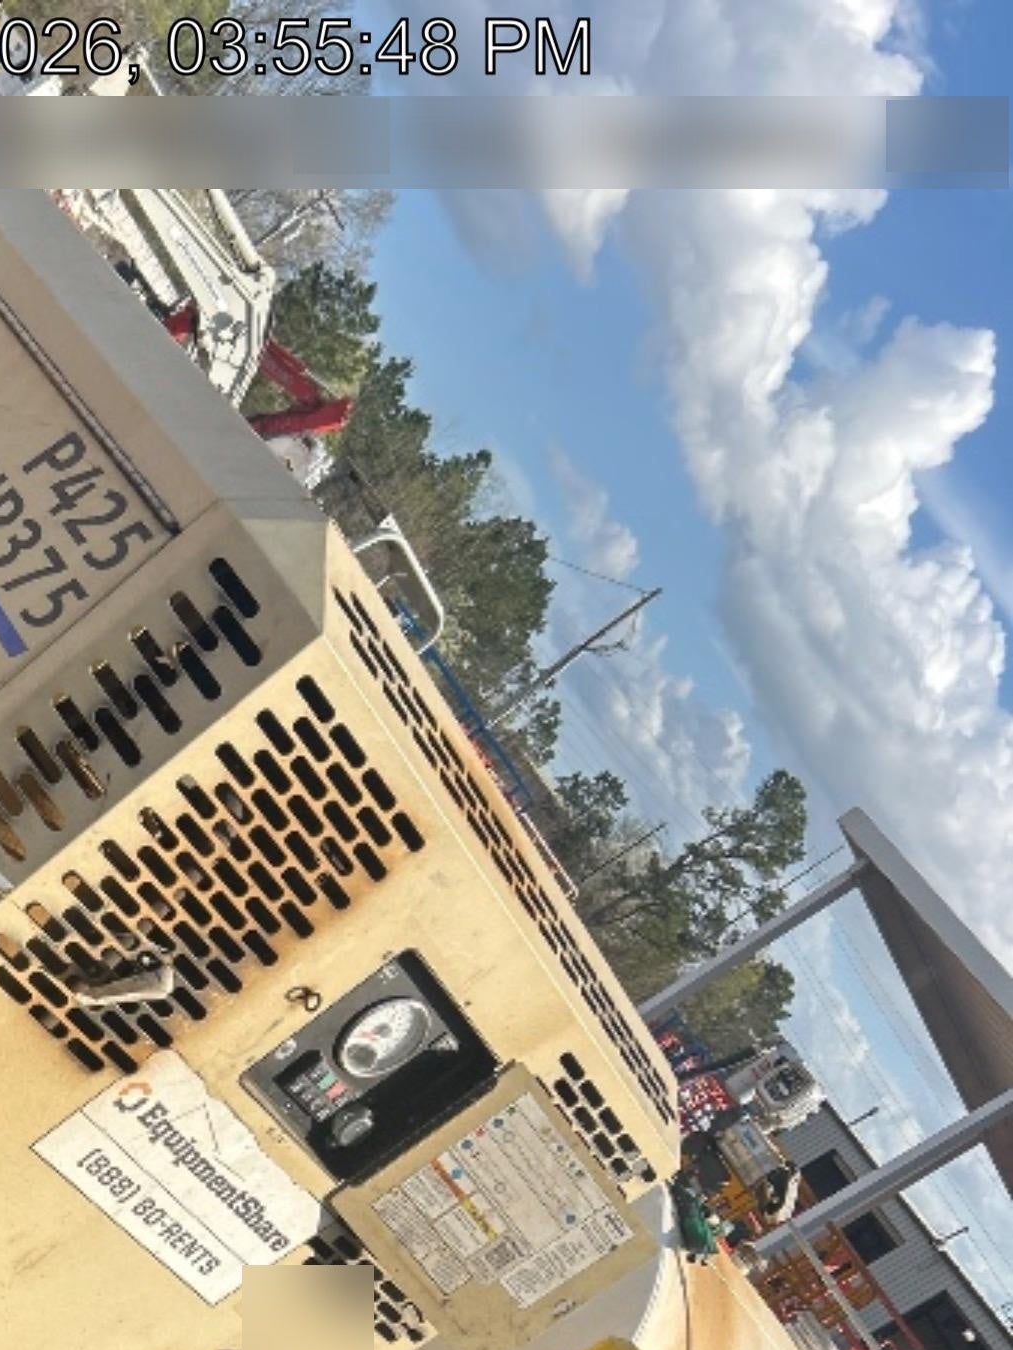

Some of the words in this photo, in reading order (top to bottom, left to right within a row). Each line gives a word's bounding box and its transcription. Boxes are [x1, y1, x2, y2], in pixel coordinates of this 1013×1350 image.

[23, 431, 153, 570] P425
[76, 1147, 140, 1204] (888)
[132, 1197, 221, 1277] 80-RENTS
[137, 1102, 291, 1252] EquipmentShare
